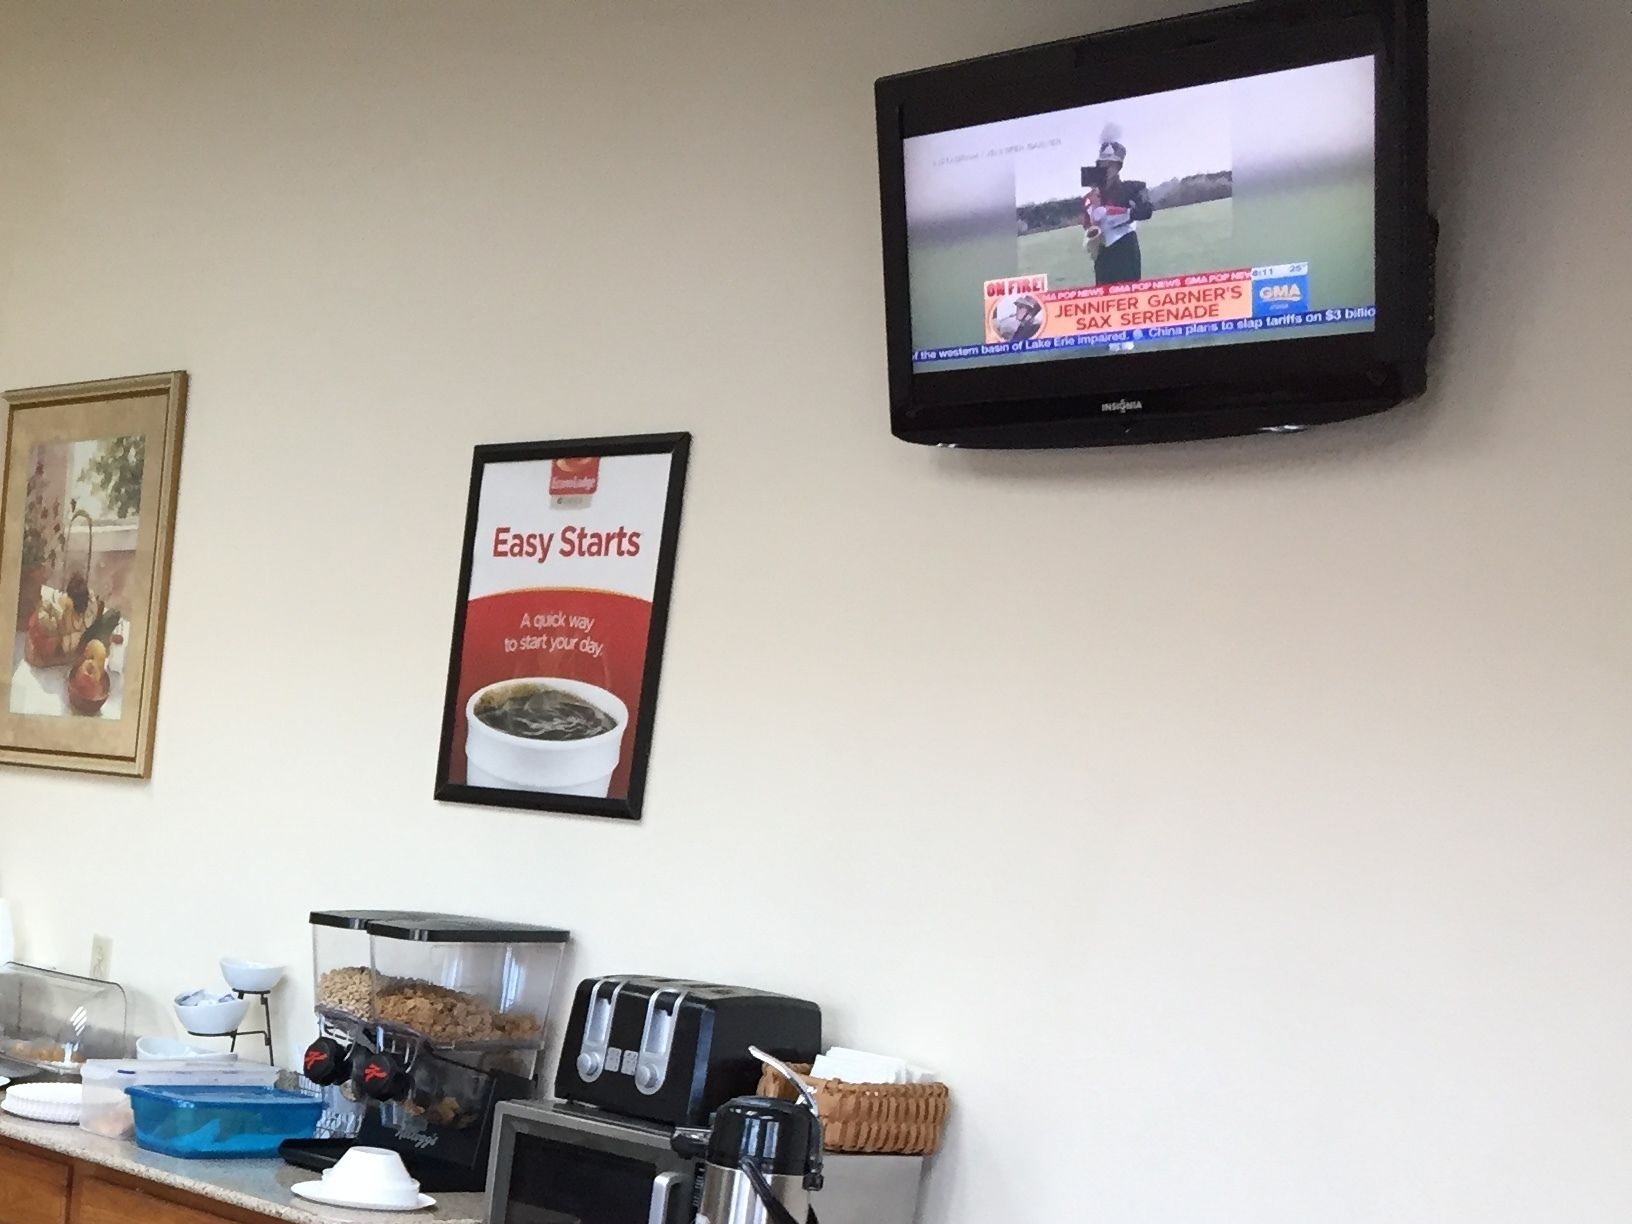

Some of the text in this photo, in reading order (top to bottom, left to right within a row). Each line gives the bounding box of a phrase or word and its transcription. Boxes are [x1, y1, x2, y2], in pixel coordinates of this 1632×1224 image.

[986, 282, 1005, 298] ON
[1132, 282, 1151, 293] POP
[1153, 278, 1181, 289] NEWS
[1209, 272, 1231, 283] POP
[1260, 283, 1301, 298] GMA
[1054, 296, 1139, 318] JENNIFER
[1148, 285, 1243, 308] GARNER'S
[1076, 303, 1219, 331] SAX SERENADE
[921, 349, 936, 360] the
[939, 344, 979, 358] western
[981, 341, 1009, 354] basin
[1011, 341, 1024, 353] of
[1025, 338, 1051, 350] Lake
[1054, 336, 1076, 348] Erie
[1077, 331, 1130, 347] impaired.
[1148, 325, 1182, 338] China
[1185, 322, 1219, 336] plans
[1221, 320, 1234, 331] to
[1236, 317, 1264, 331] slap
[1266, 313, 1302, 328] tariffs
[1306, 312, 1323, 323] on
[1325, 308, 1342, 322] $3
[493, 525, 642, 564] Easy Starts
[520, 611, 596, 633] A quick way
[504, 637, 518, 653] to
[520, 633, 548, 651] start
[549, 635, 579, 653] your
